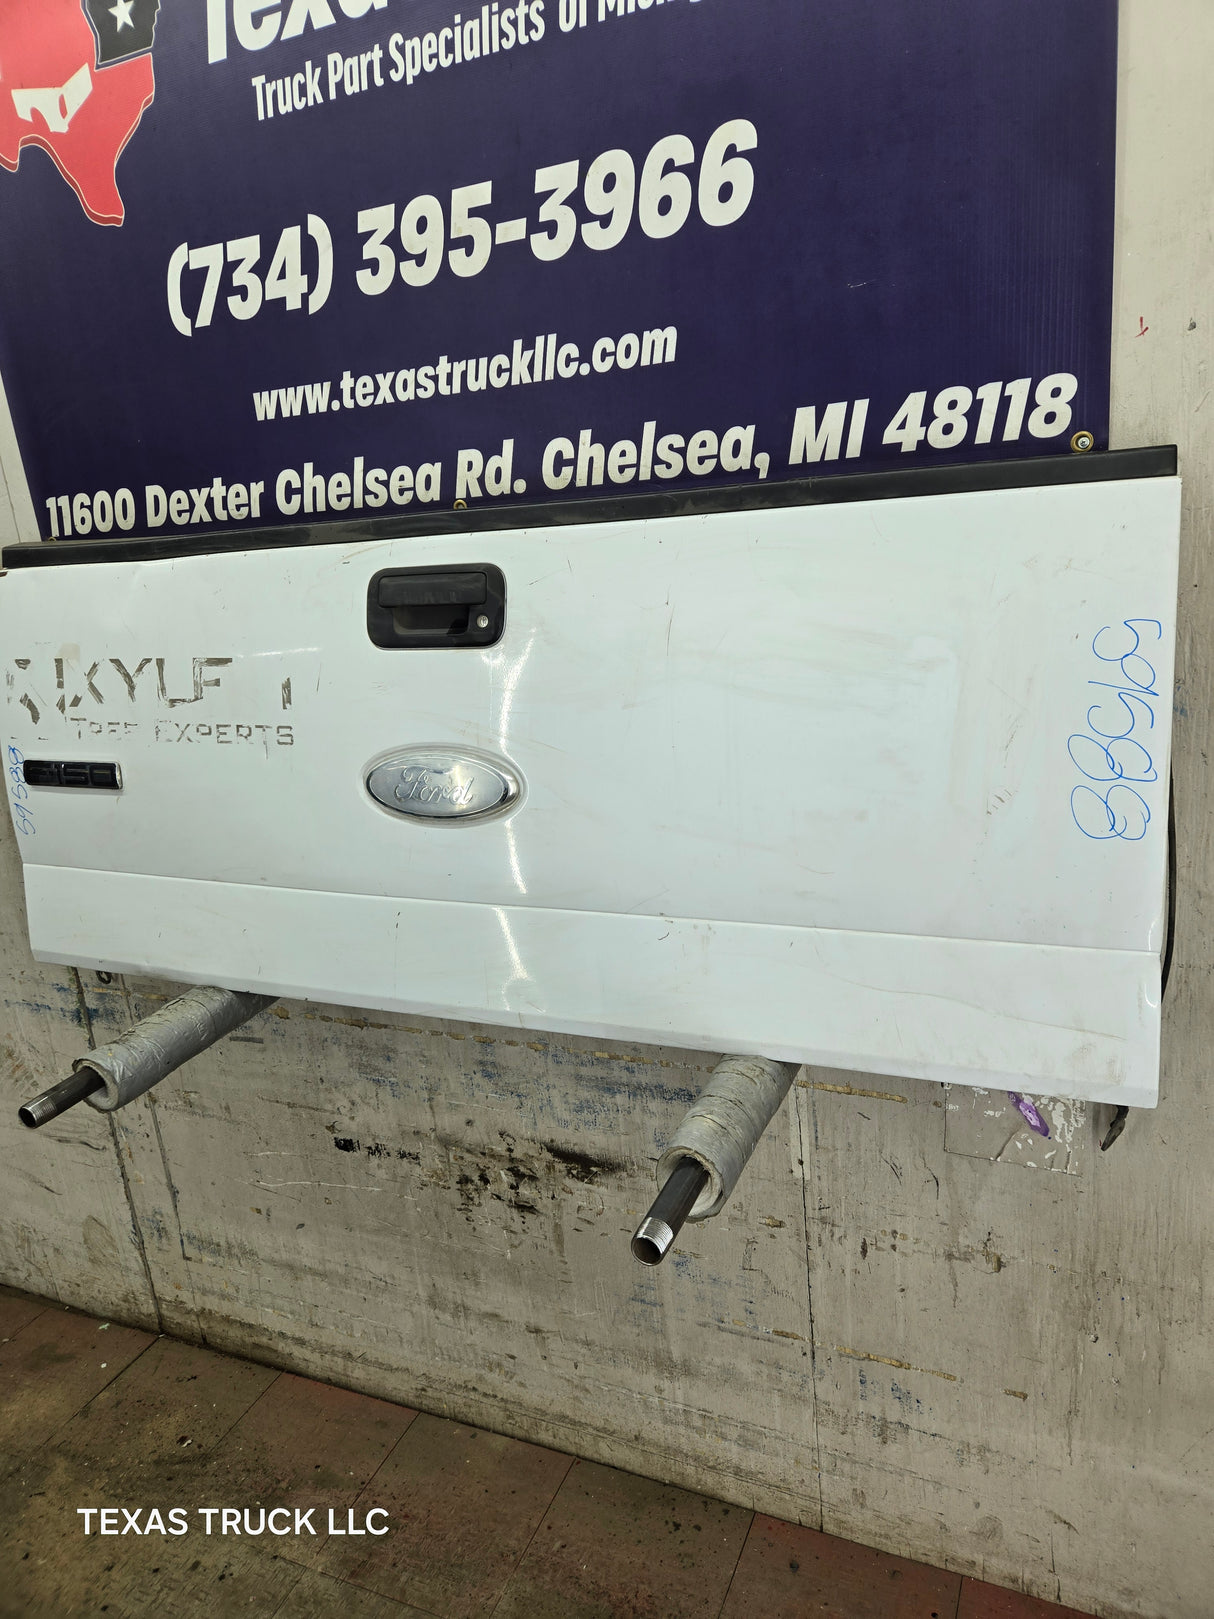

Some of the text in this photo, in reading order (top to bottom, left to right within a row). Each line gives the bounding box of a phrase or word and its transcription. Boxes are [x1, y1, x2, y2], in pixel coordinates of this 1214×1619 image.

[252, 60, 323, 121] Truck
[327, 44, 384, 100] Part
[389, 0, 545, 85] Specialists
[166, 119, 757, 336] (734) 395-3966
[253, 326, 677, 421] www.texastruckllc.com
[46, 373, 1078, 538] 11600 Dexter Chelsea Rd. Chelsea, MI 48118
[395, 766, 475, 806] Ford
